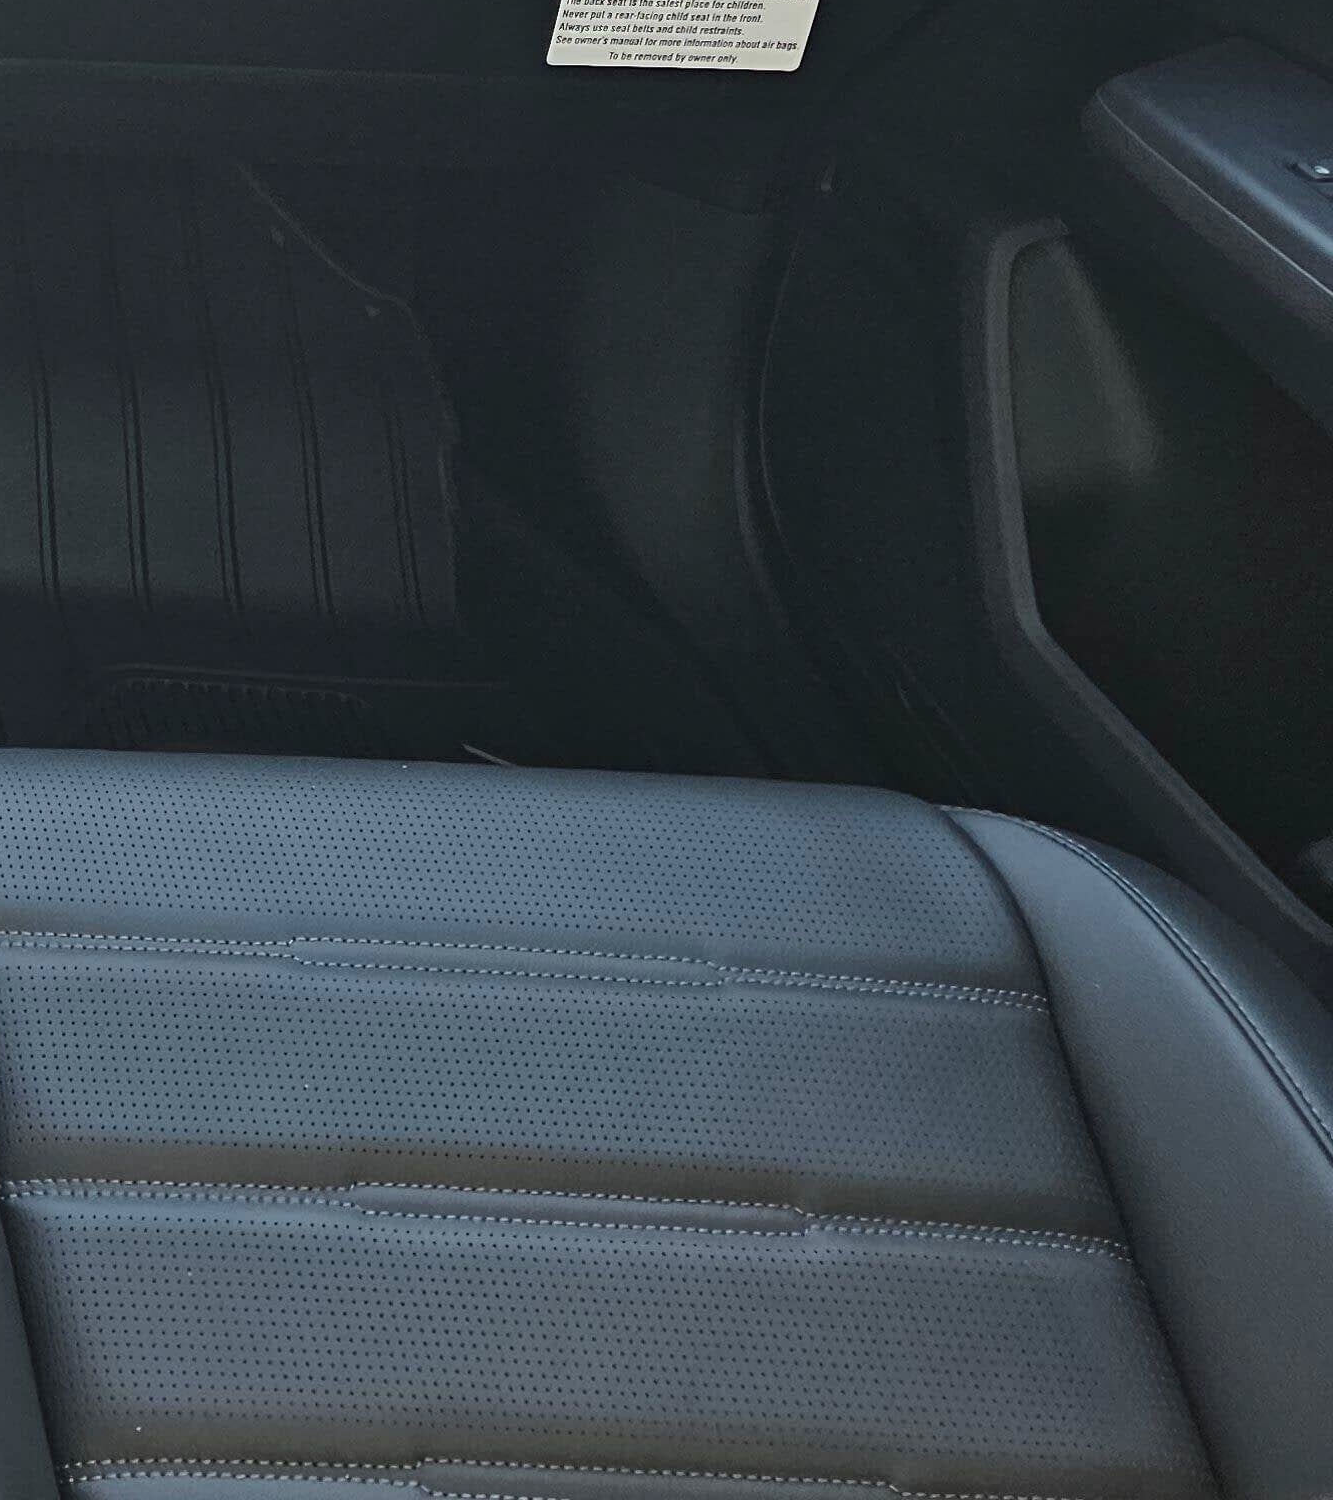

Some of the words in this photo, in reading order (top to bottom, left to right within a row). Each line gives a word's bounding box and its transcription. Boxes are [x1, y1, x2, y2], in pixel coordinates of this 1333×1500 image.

[685, 0, 710, 9] place
[712, 0, 725, 9] for
[727, 0, 766, 10] children.
[562, 10, 588, 19] Never
[590, 10, 605, 20] put
[615, 11, 664, 22] rear-facing
[666, 12, 688, 21] child
[690, 12, 710, 21] seat
[712, 13, 721, 22] in
[723, 13, 737, 22] the
[558, 23, 590, 33] Always
[593, 24, 608, 32] use
[611, 24, 630, 33] seat
[632, 24, 654, 33] belts
[655, 24, 673, 34] and
[675, 26, 698, 34] child
[556, 35, 572, 45] See
[574, 36, 608, 45] owner's
[610, 36, 643, 46] manual
[644, 37, 657, 46] for
[659, 38, 682, 47] more
[683, 39, 734, 48] information
[735, 40, 760, 49] about
[761, 40, 775, 49] air
[608, 51, 619, 60] To
[621, 52, 632, 60] be
[634, 53, 673, 61] removed
[675, 53, 686, 62] by
[688, 54, 716, 62] owner
[717, 54, 738, 64] only.
